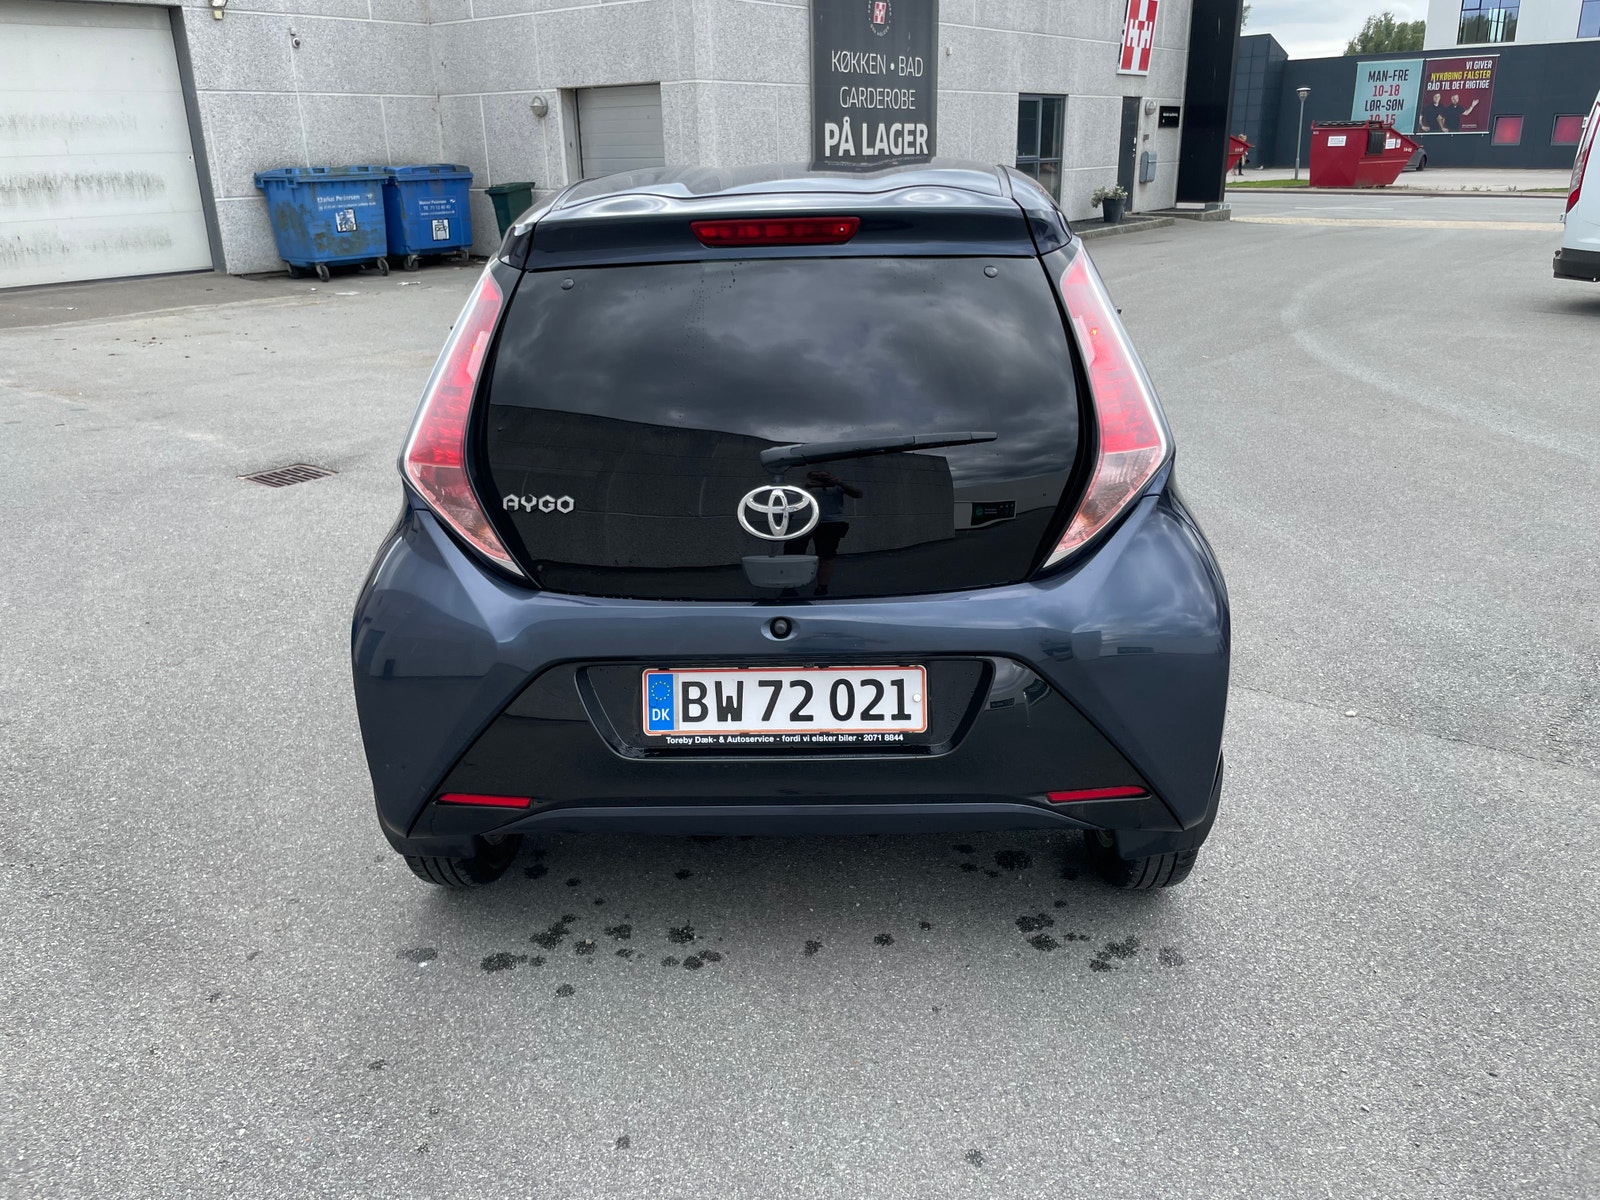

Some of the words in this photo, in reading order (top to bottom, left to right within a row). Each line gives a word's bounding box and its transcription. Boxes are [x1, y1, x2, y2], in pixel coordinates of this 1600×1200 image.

[832, 50, 886, 75] KØKKEN
[899, 56, 924, 77] BAD
[1466, 61, 1473, 70] VI
[1473, 60, 1493, 69] GIVER
[1368, 68, 1409, 82] MAN-FRE
[1431, 71, 1462, 81] NYKØBING
[1464, 69, 1491, 80] FALSTER
[1372, 84, 1400, 97] 10-18
[1427, 79, 1440, 91] RÅD
[1441, 81, 1451, 90] TIL
[1452, 80, 1464, 90] DET
[1465, 79, 1490, 90] RIGTIGE
[839, 86, 916, 110] GARDEROBE
[1364, 98, 1404, 112] LØR-SØN
[824, 116, 856, 157] PÅ
[862, 123, 929, 156] LAGER
[502, 493, 575, 514] AYGO
[681, 680, 744, 723] BW
[758, 679, 814, 722] 72
[829, 678, 912, 722] 021
[652, 708, 670, 721] DK
[666, 736, 693, 745] Toreby
[718, 735, 725, 744] &
[727, 735, 775, 743] Autoservice
[781, 734, 801, 742] fordi
[802, 734, 810, 742] vi
[811, 734, 837, 742] elsker
[838, 734, 857, 742] biler
[863, 733, 882, 742] 2071
[884, 733, 904, 742] 8844
